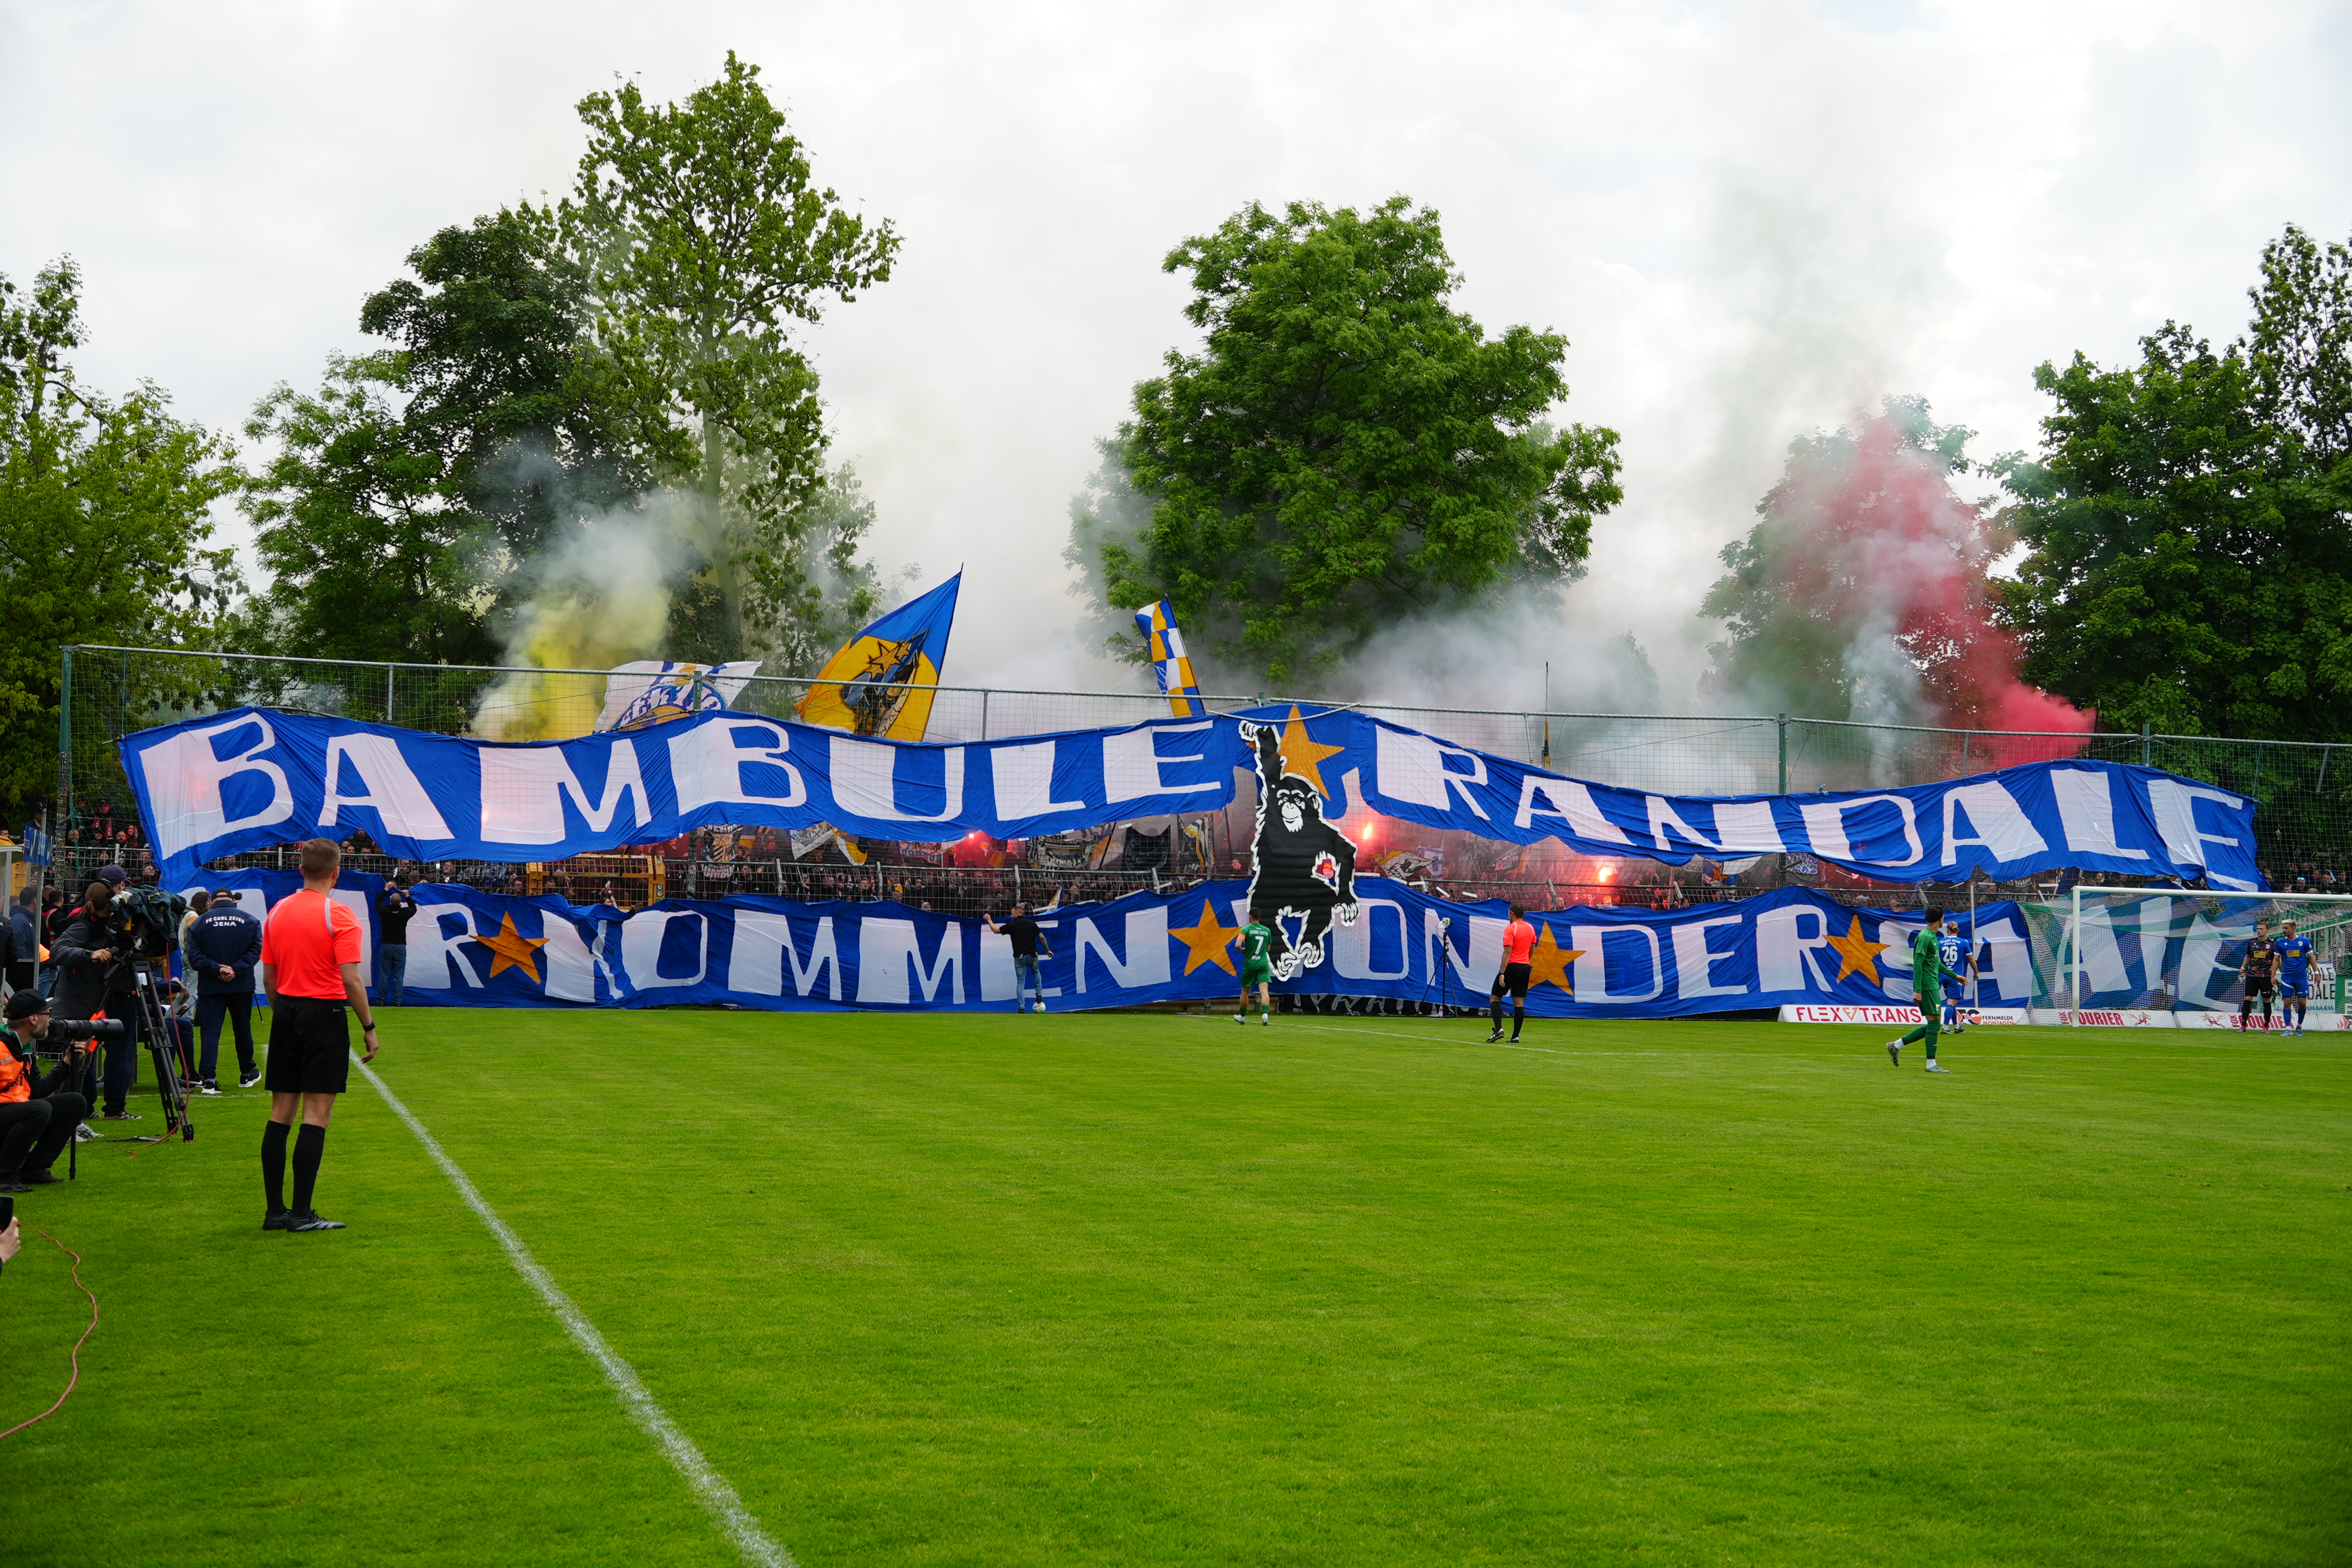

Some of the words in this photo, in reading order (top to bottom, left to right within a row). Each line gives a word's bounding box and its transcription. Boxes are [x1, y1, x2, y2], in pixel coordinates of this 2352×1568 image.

[139, 713, 1221, 860] BAMBULE
[1376, 725, 2258, 892] RANDALE
[541, 906, 1171, 1004] KOMMEN
[1231, 899, 1512, 997] ON
[1572, 904, 1833, 1004] DER
[1255, 936, 1263, 954] 7
[1942, 946, 1957, 962] 26
[1796, 1007, 1843, 1022] FLEX
[1858, 1008, 1922, 1023] TRANS
